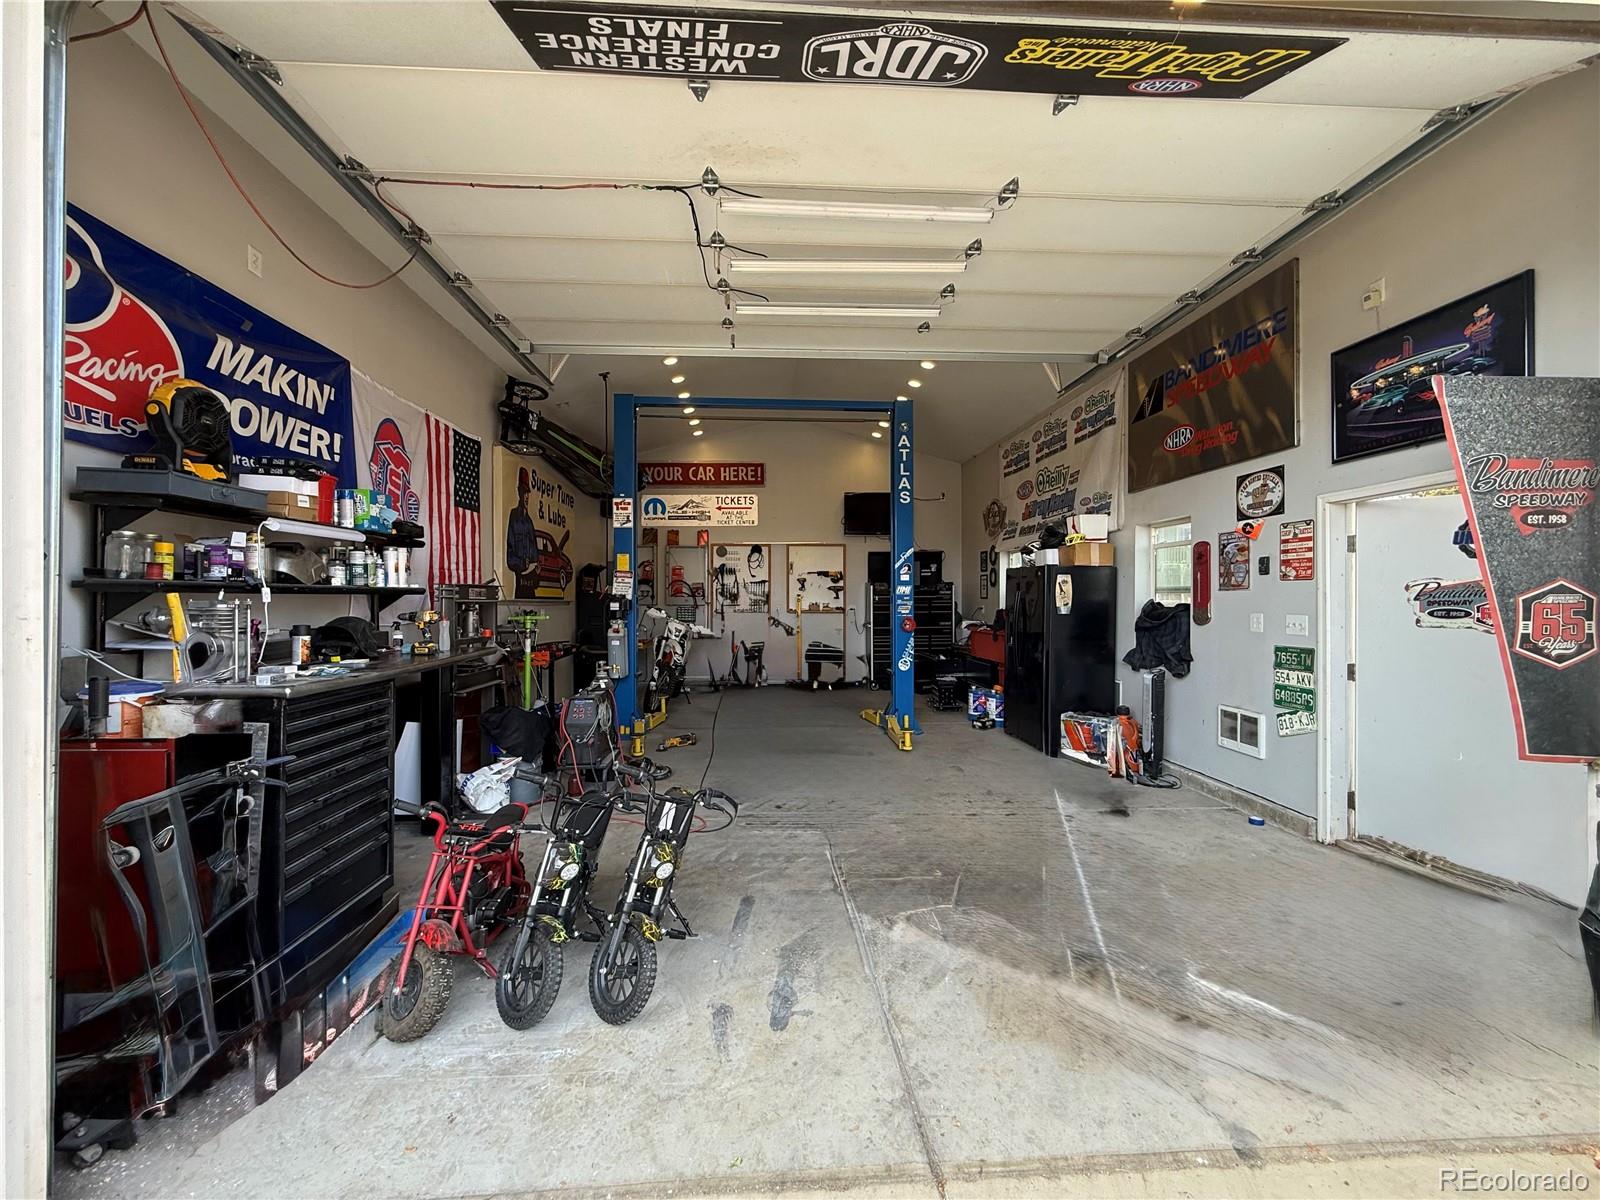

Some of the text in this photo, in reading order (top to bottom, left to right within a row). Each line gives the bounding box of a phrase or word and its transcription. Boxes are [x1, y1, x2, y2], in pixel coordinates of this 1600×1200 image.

[588, 17, 728, 39] FINALS
[881, 25, 926, 37] NHRA
[535, 32, 780, 58] CONFERENCE
[1053, 36, 1166, 51] Nationwide
[574, 52, 748, 74] WESTERN
[820, 37, 971, 80] JDRL
[1004, 45, 1311, 81] Right Trailers
[1139, 79, 1193, 92] NHRA
[1165, 305, 1288, 392] BANDIMERE
[206, 333, 335, 415] MAKIN'
[1166, 335, 1277, 409] SPEEDWAY
[65, 401, 139, 437] UELS
[1166, 427, 1192, 449] NHRA
[376, 441, 411, 518] SUM
[644, 466, 762, 483] YOUR CAR HERE!
[898, 435, 911, 504] ATLAS
[1035, 465, 1070, 496] O'Reilly
[1467, 453, 1599, 492] Bandimere
[529, 469, 575, 509] Super Tune
[715, 496, 755, 506] TICKETS
[1494, 491, 1587, 508] SPEEDWAY
[408, 496, 418, 521] NHR
[538, 500, 566, 529] & Lube
[1527, 513, 1567, 524] EST. 1958
[1411, 582, 1488, 601] Bandim
[1426, 599, 1474, 607] SPEEDWAY
[1531, 601, 1587, 644] 65
[1538, 637, 1578, 656] Years
